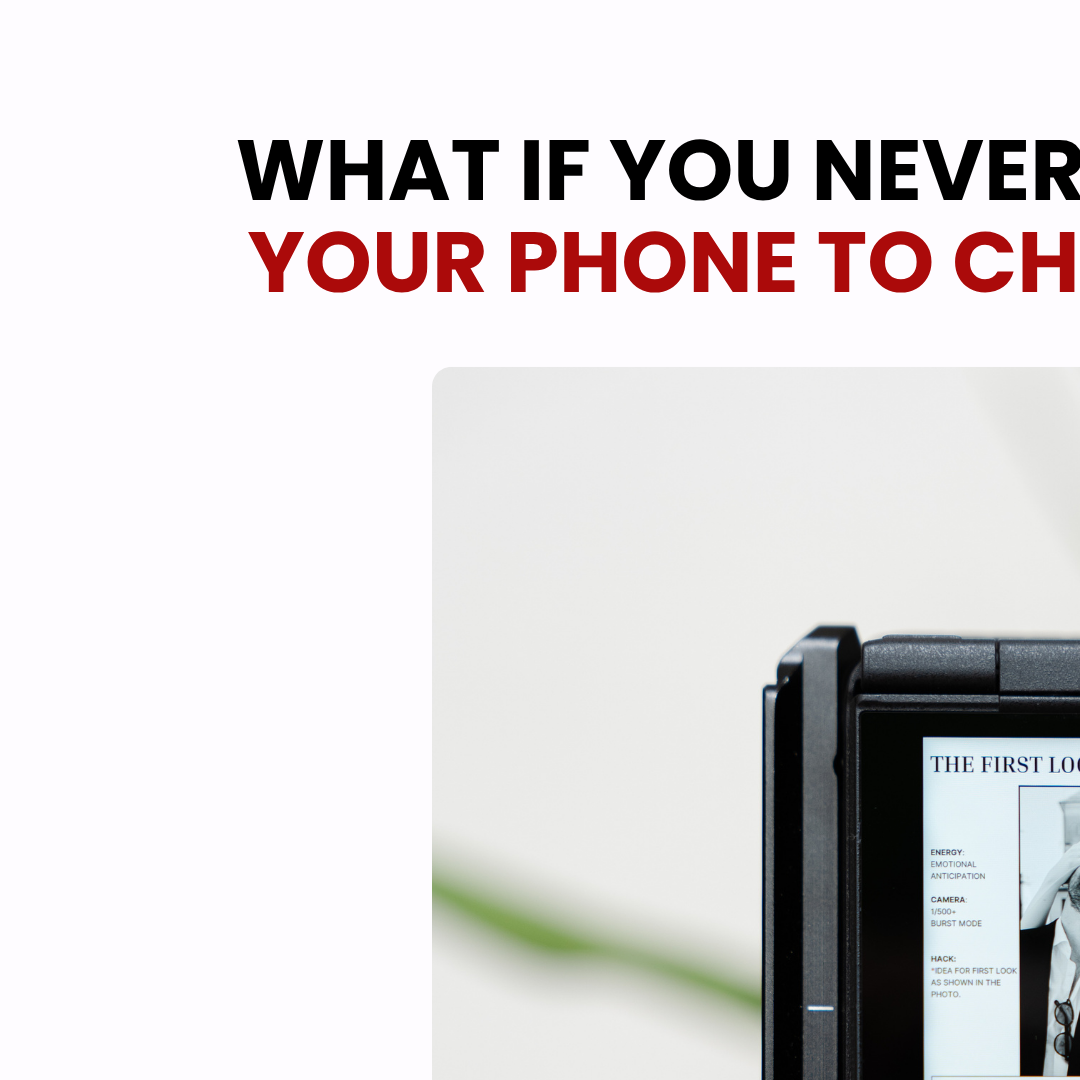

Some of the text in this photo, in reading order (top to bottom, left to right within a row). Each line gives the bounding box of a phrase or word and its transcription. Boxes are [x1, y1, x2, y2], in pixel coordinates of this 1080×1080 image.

[929, 755, 975, 773] THE
[981, 755, 1044, 774] FIRST
[930, 848, 965, 857] ENERGY:
[930, 860, 977, 869] EMOTIONAL
[930, 872, 986, 880] ANTICIPATION
[930, 895, 968, 904] CAMERA:
[930, 907, 957, 916] 1/500+
[930, 919, 983, 928] BURST MODE
[930, 955, 957, 963] HACK:
[954, 966, 971, 975] FOR
[971, 966, 995, 975] FIRST
[995, 966, 1018, 975] LOOK
[930, 978, 1002, 987] AS SHOWN IN THE
[930, 990, 961, 999] PHOTO.
